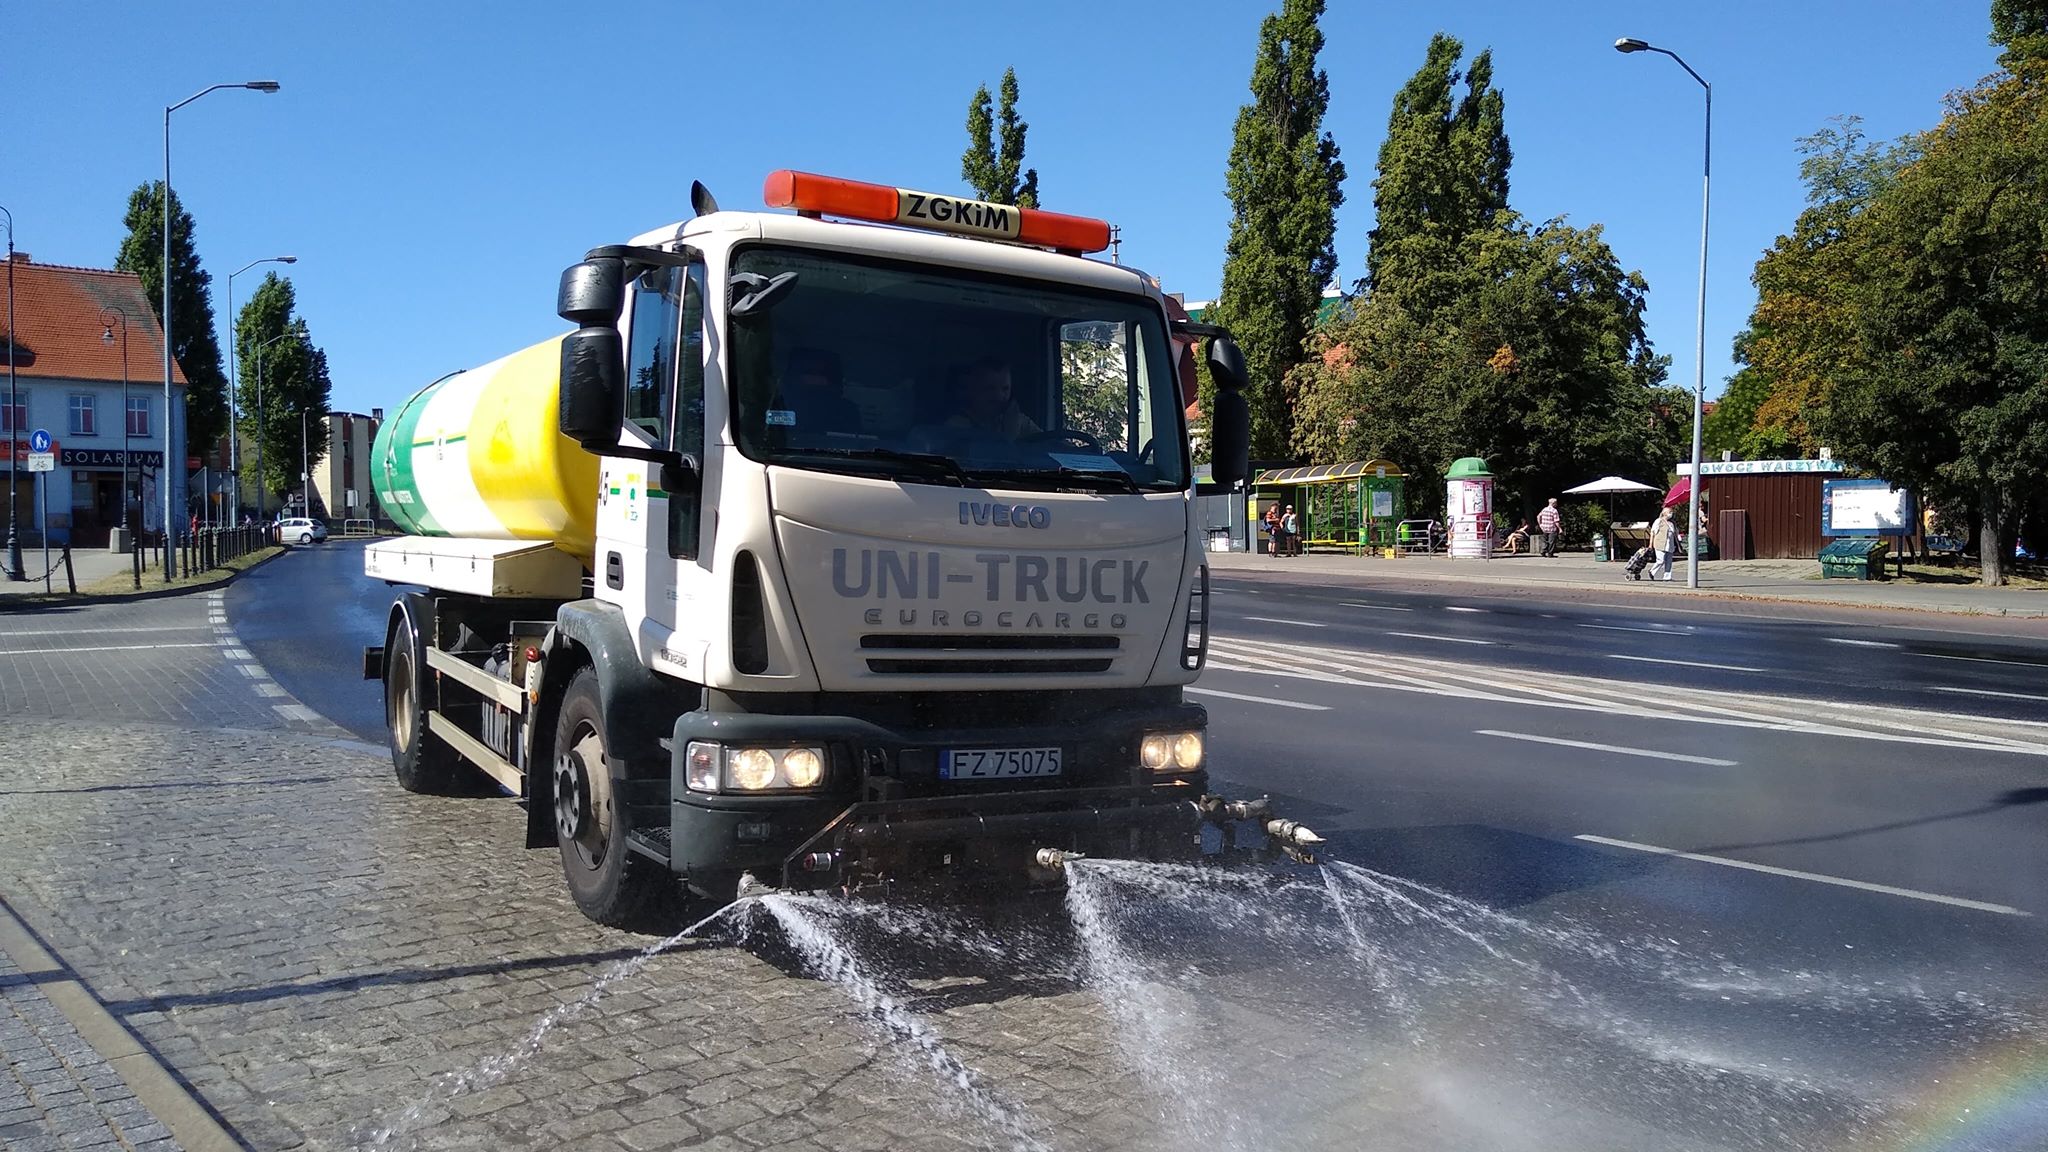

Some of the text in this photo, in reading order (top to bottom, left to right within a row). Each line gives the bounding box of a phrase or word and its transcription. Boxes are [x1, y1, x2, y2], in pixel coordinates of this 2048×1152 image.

[907, 194, 1009, 232] ZGKiM
[64, 451, 160, 464] SOLARIUM
[1701, 463, 1753, 474] OWOCE
[959, 501, 1051, 529] IVECO
[832, 548, 1150, 604] UNI-TRUCK
[864, 608, 1127, 629] EUROCARGO
[953, 750, 1059, 777] FZ 75075
